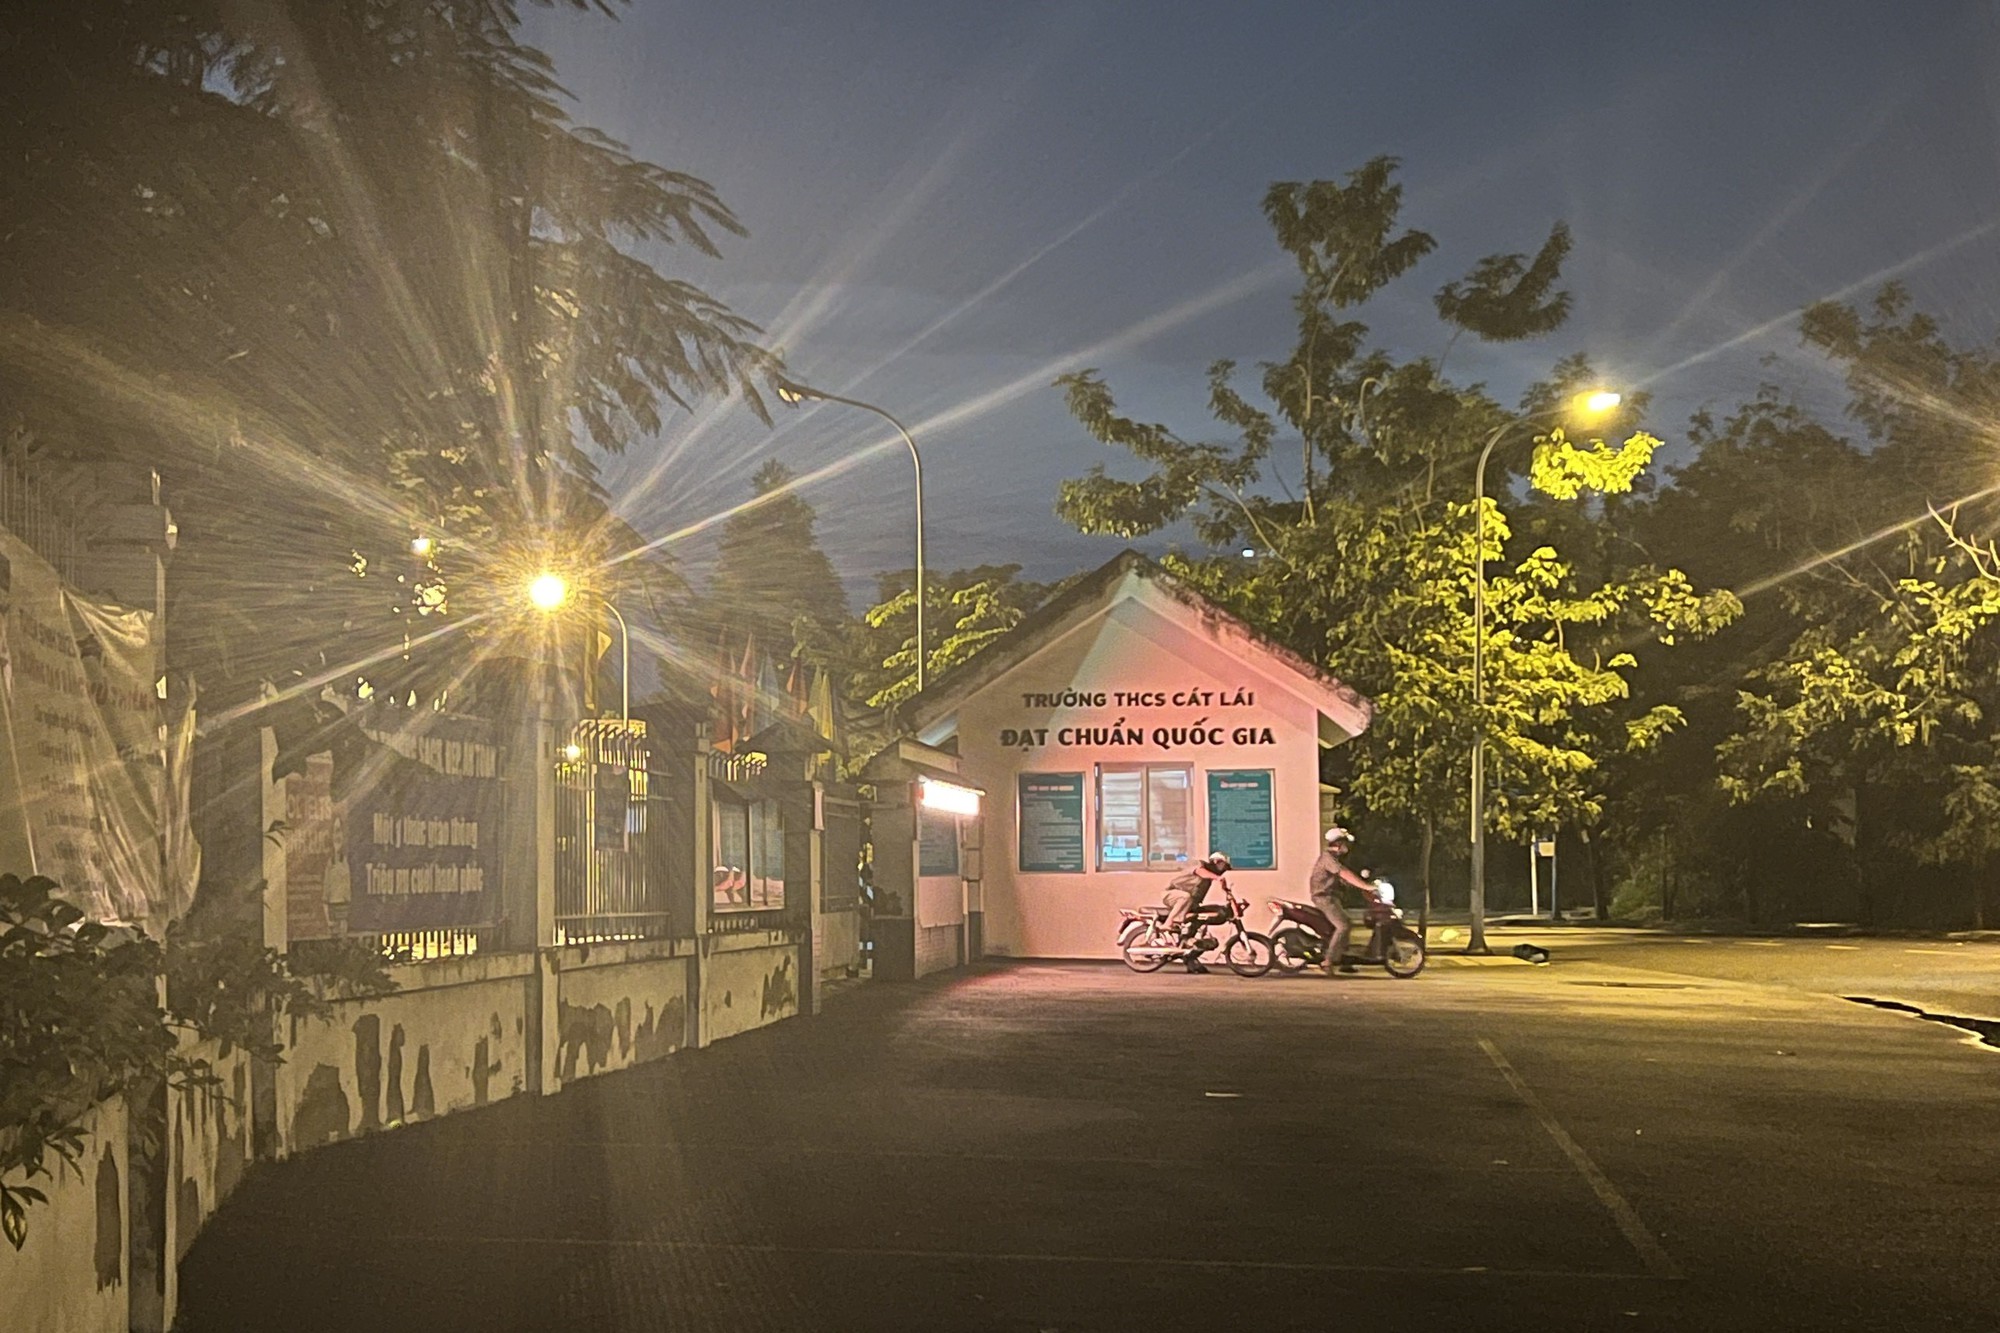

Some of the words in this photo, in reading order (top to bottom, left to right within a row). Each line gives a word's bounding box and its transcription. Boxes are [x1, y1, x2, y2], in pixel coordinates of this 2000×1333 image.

[1022, 687, 1107, 708] TRƯỜNG
[1113, 692, 1167, 708] THCS
[1172, 686, 1215, 707] CÁT
[1219, 686, 1255, 707] LÁI
[1001, 728, 1049, 752] ĐẠT
[1057, 716, 1144, 746] CHUẨN
[1152, 716, 1225, 750] QUỐC
[1231, 727, 1277, 746] GIA
